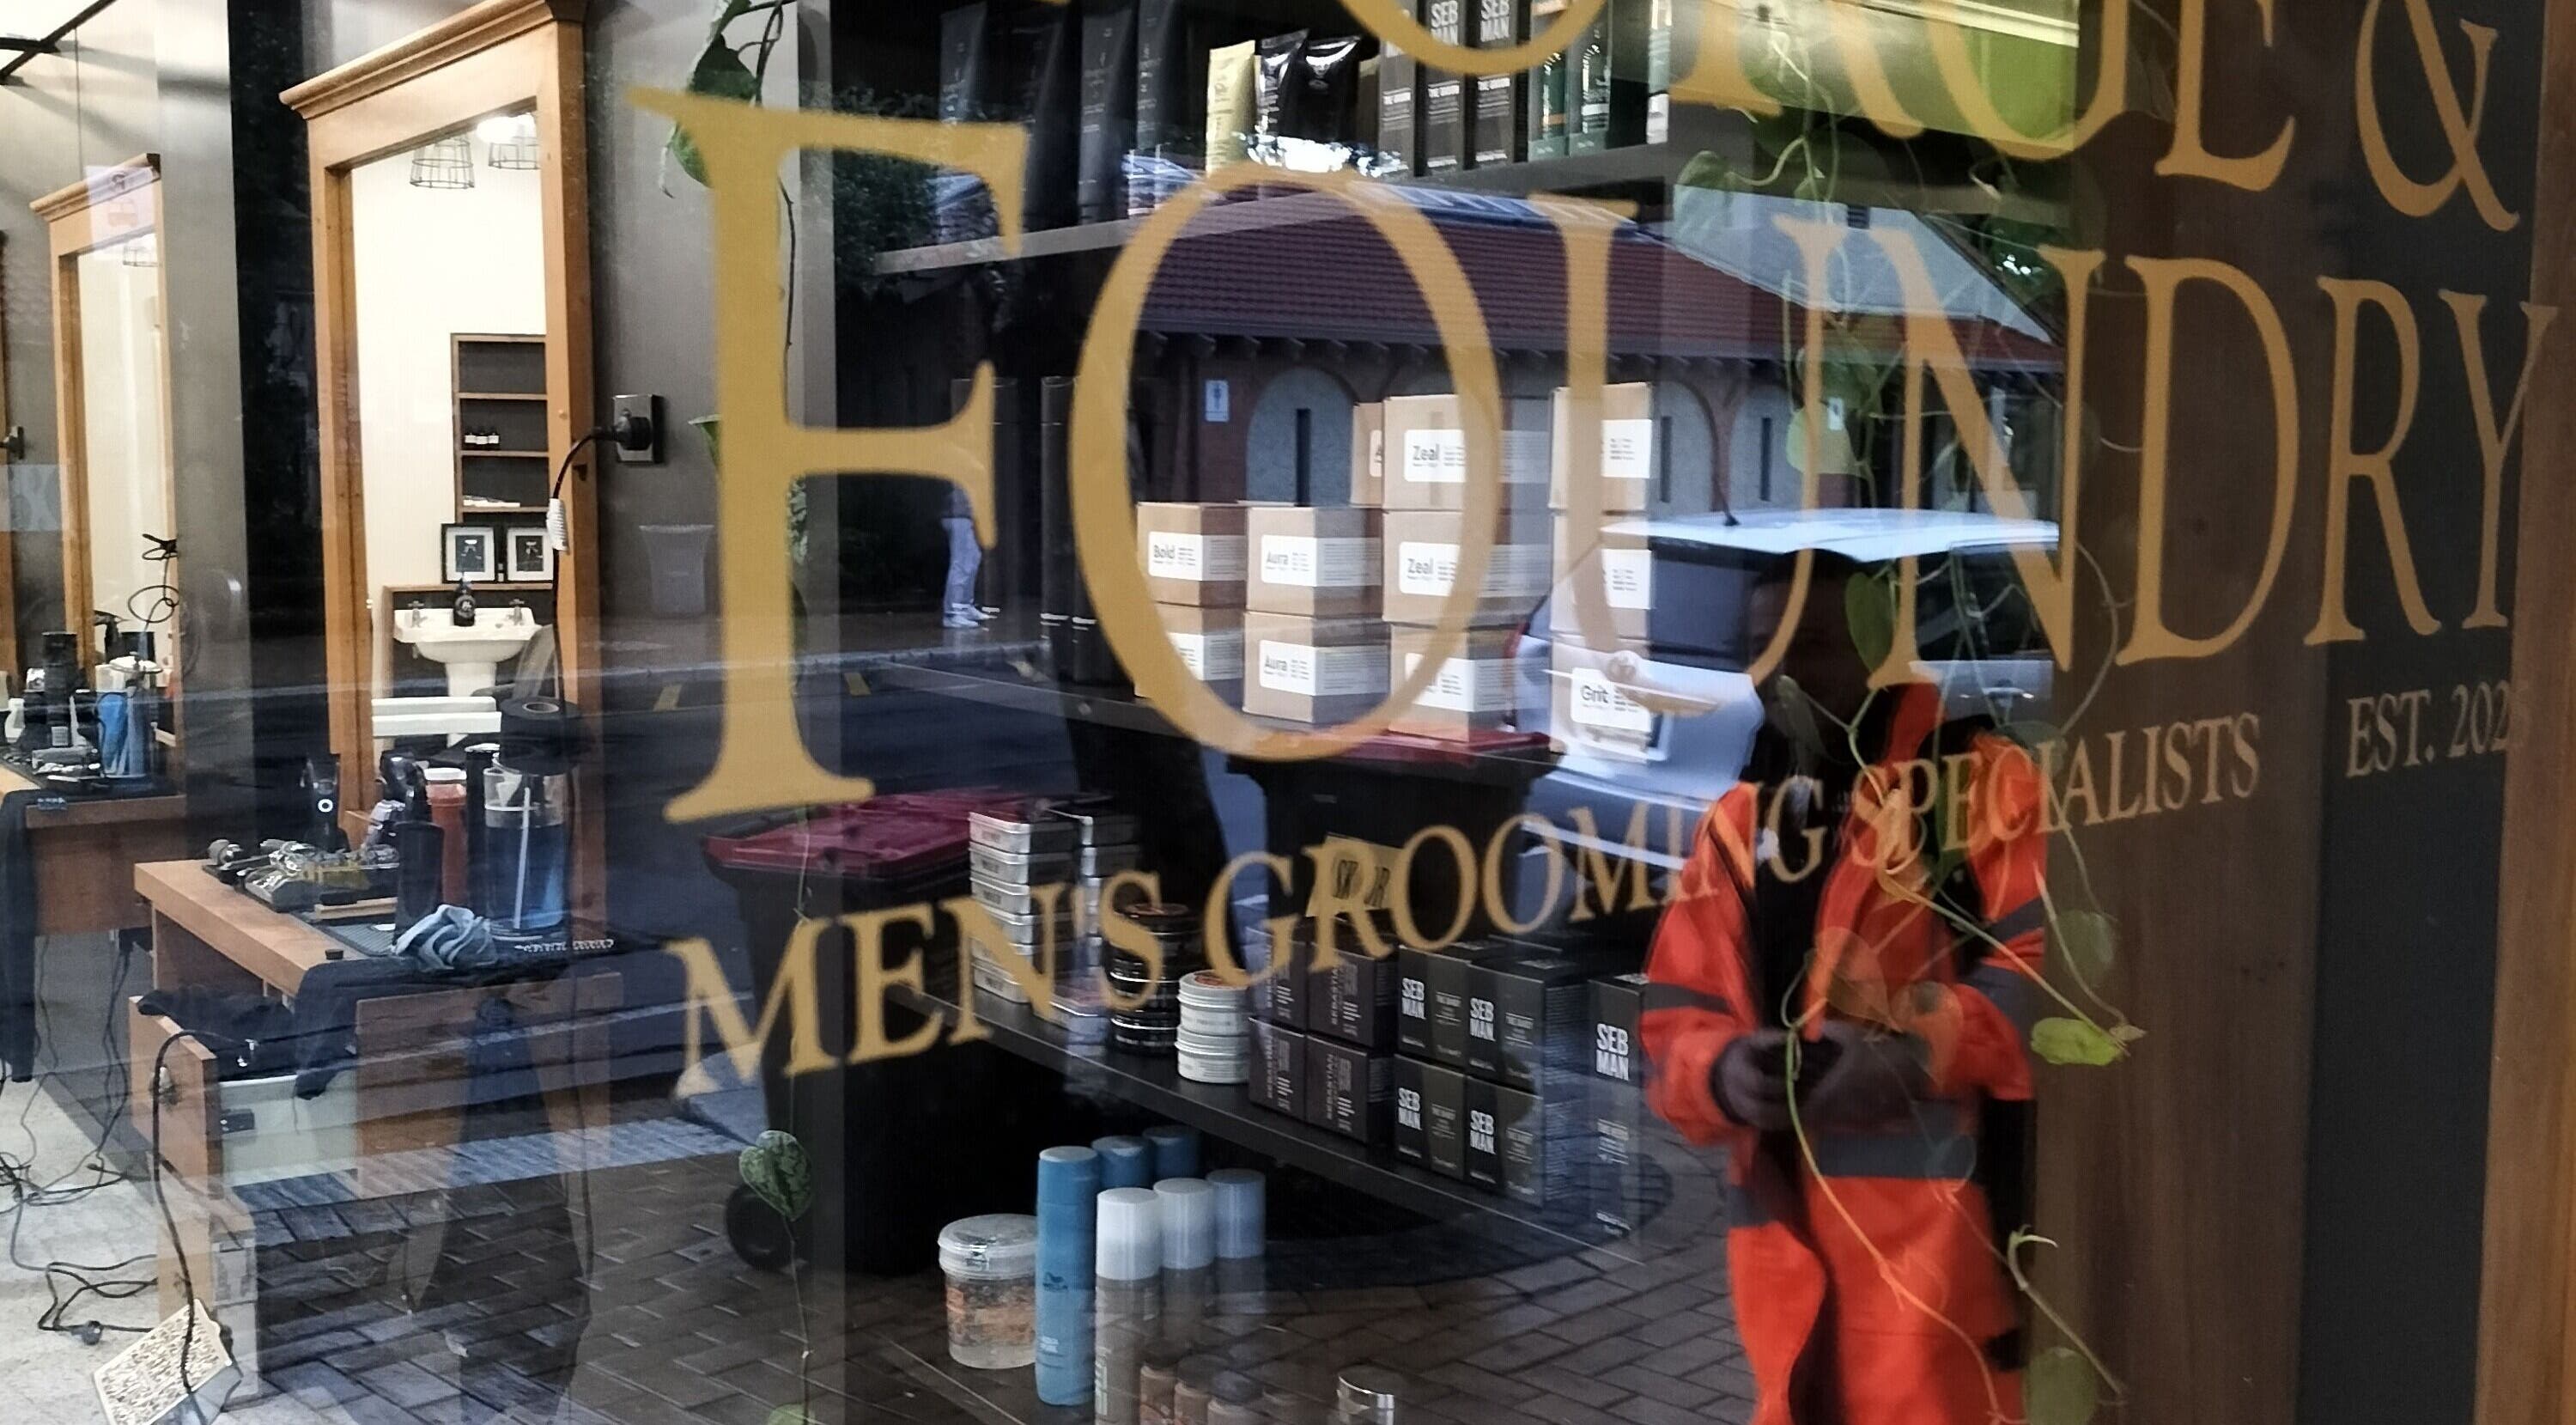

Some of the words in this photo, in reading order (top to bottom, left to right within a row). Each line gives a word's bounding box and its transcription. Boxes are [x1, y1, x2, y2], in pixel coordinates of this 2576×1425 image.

[1431, 0, 1458, 27] SEB
[1481, 16, 1510, 43] MAN
[623, 84, 2559, 823] FOUNDRY
[1413, 443, 1440, 460] Zeal
[1153, 544, 1176, 559] Bold
[1265, 551, 1289, 565] Aura
[1407, 557, 1434, 575] Zeal
[1264, 655, 1287, 672] Aura
[1580, 684, 1609, 704] Grit
[2344, 689, 2435, 779] EST.
[664, 870, 1164, 1101] MEN'S
[1204, 773, 1829, 987] GROOMING
[1850, 712, 2261, 868] SPECIALISTS
[1401, 977, 1425, 1002] SEB
[1401, 997, 1426, 1020] MAN
[1469, 996, 1495, 1022] SEB
[1469, 1018, 1496, 1042] MAN
[1596, 1022, 1629, 1056] SEB
[1595, 1048, 1629, 1081] MAN
[1398, 1087, 1421, 1111] SEB
[1398, 1106, 1422, 1130] MAN
[1469, 1110, 1495, 1136] SEB
[1469, 1130, 1496, 1155] MAN
